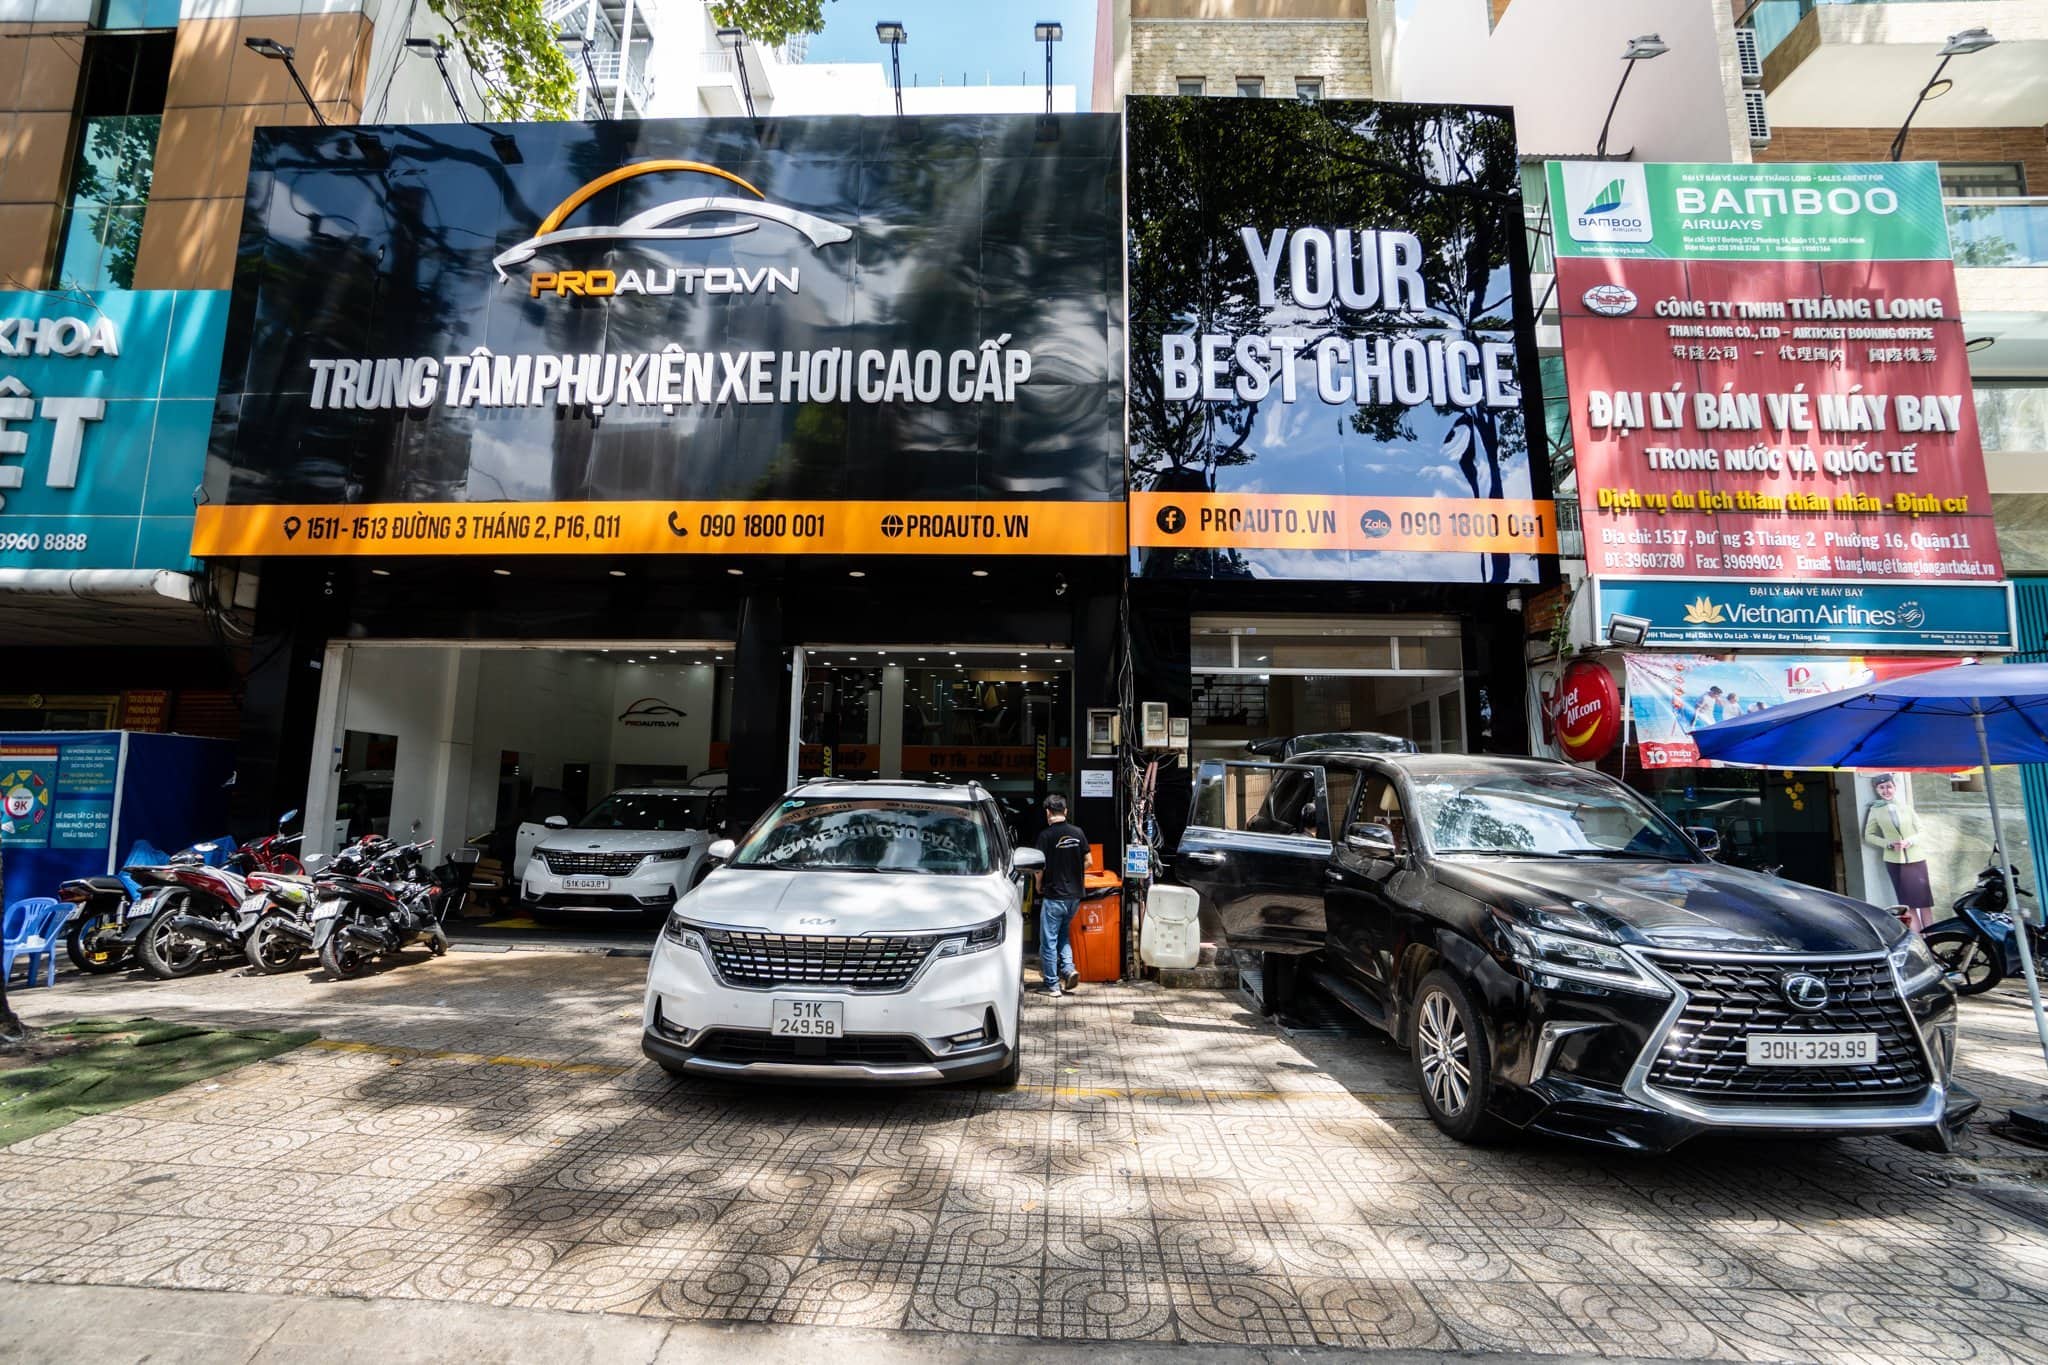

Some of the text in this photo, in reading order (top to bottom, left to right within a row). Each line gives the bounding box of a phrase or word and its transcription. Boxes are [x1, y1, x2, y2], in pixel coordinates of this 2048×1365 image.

[1675, 187, 1899, 217] BAMBOO
[1578, 217, 1642, 228] BAMBOO
[1681, 219, 1763, 231] AIRWAYS
[1240, 226, 1427, 313] YOUR
[530, 266, 800, 298] PROAUTO.VN
[1655, 296, 1706, 317] CÔNG
[1708, 301, 1733, 318] TY
[1736, 302, 1786, 319] TNHH
[1875, 297, 1944, 319] LONG
[0, 316, 119, 357] KHOA
[1667, 324, 1705, 337] THANG
[1705, 325, 1734, 338] LONG
[1760, 327, 1780, 339] LTD
[1793, 327, 1847, 339] AIRTICKET
[1847, 327, 1896, 340] BOOKING
[1896, 328, 1934, 340] OFFICE
[308, 333, 1032, 416] TRUNG TÂM PHỤ KIỆN XE HƠI CAO CẤP
[1161, 334, 1522, 408] BEST CHOICE
[1588, 382, 1963, 438] ĐẠI LÝ BÁN VÉ MÁY BAY
[1645, 442, 1918, 476] TRONG NƯỚC VÀ QUỐC TẾ
[1598, 488, 1641, 514] Dịch
[1644, 493, 1668, 515] vụ
[1671, 489, 1695, 510] du
[1697, 489, 1733, 515] lịch
[1833, 491, 1882, 512] nhân
[1894, 492, 1941, 519] Định
[306, 516, 340, 539] 1511
[352, 515, 386, 539] 1513
[391, 510, 451, 539] ĐƯỜNG
[455, 515, 467, 539] 3
[472, 511, 531, 539] THÁNG
[700, 514, 825, 537] 090 1800 001
[906, 514, 1029, 538] PROAUTO.VN
[1200, 507, 1337, 534] PROAUTO.VN
[1400, 511, 1544, 538] 090 1800 001
[43, 533, 87, 550] 8888
[1601, 529, 1625, 548] Địa
[1743, 530, 1755, 546] 3
[1756, 530, 1801, 550] Tháng
[1805, 532, 1817, 547] 2
[1722, 554, 1785, 570] 39699024
[1750, 586, 1864, 598] ĐẠI LÝ BÁN VÉ MÁY BAY
[13, 801, 28, 811] 9K
[793, 1002, 823, 1018] 51K
[780, 1018, 835, 1035] 249.58
[1760, 1040, 1867, 1060] 30H-329.99
